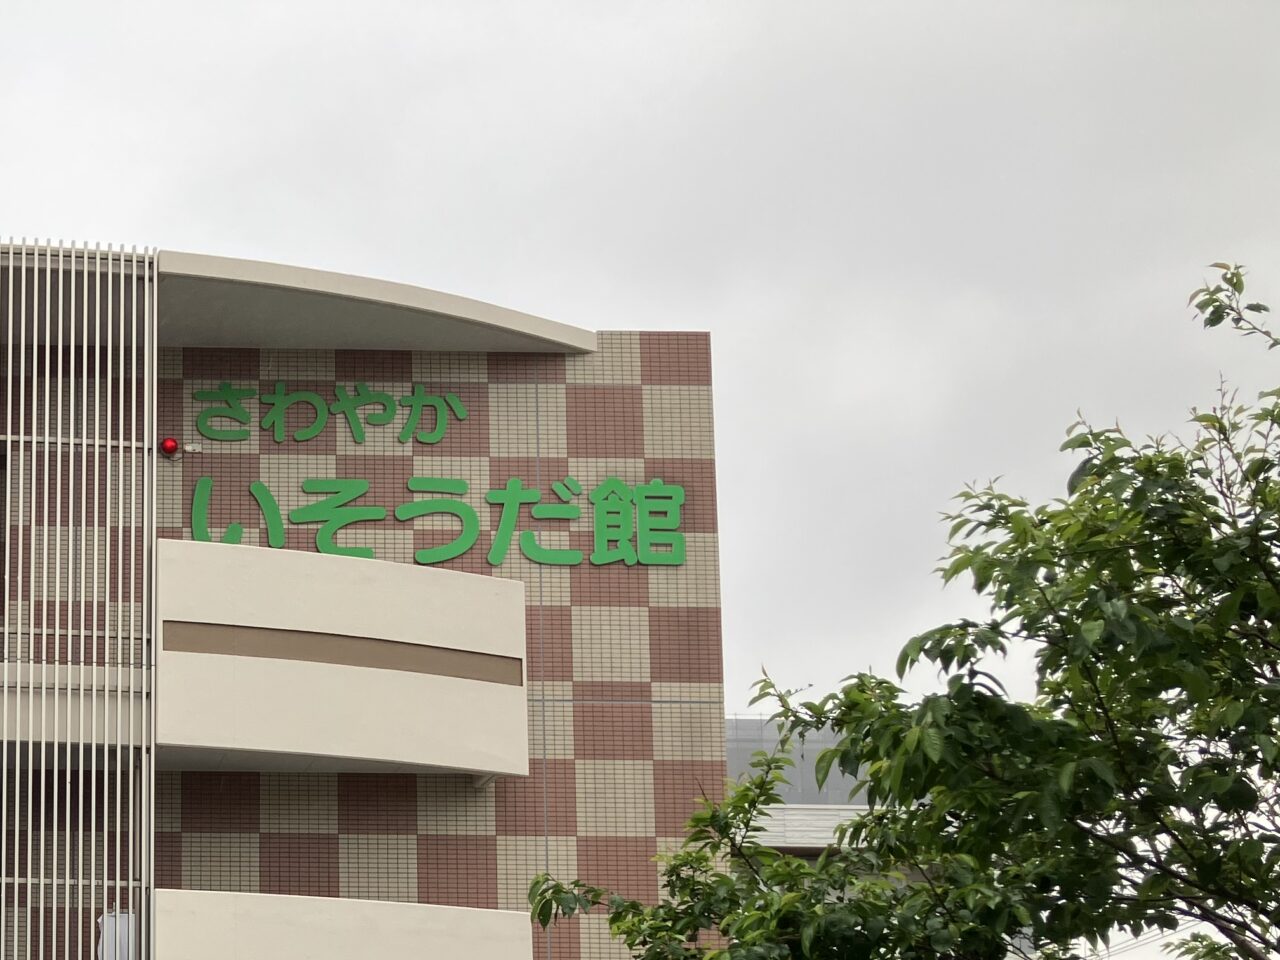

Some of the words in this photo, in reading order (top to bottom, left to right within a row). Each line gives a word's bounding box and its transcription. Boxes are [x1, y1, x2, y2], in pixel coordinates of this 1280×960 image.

[192, 381, 468, 444] さわやか
[190, 475, 686, 567] いそうだ館
